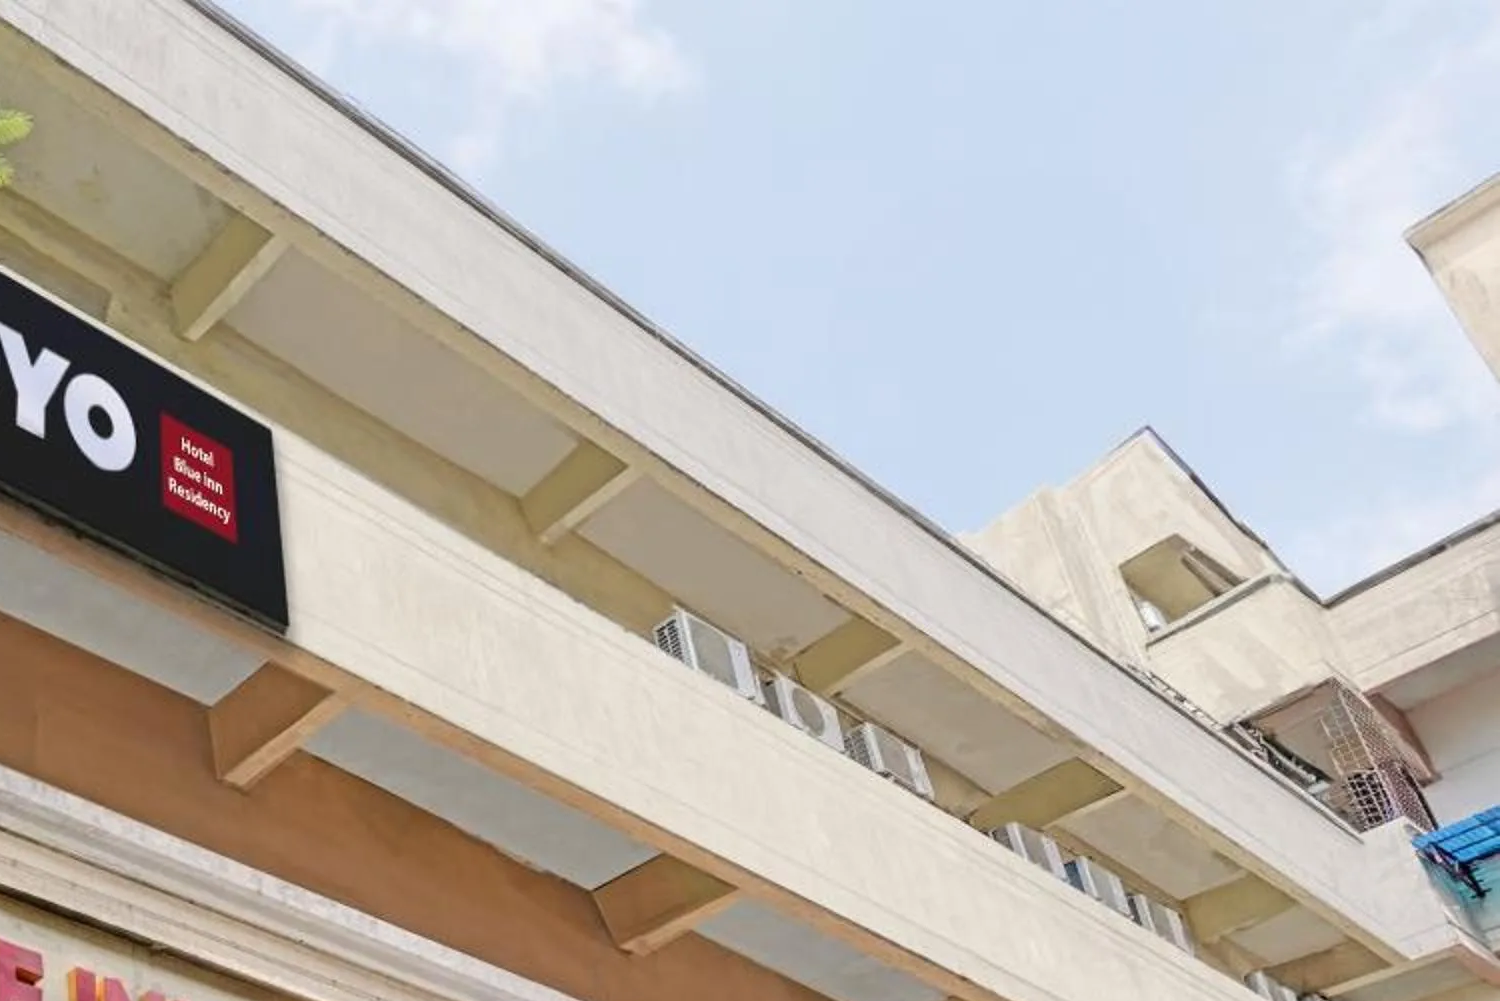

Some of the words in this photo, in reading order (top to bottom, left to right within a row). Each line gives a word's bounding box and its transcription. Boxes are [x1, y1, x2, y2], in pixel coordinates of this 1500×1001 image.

[181, 437, 214, 467] Hotel
[173, 456, 201, 483] Blue
[167, 477, 231, 524] Residency
